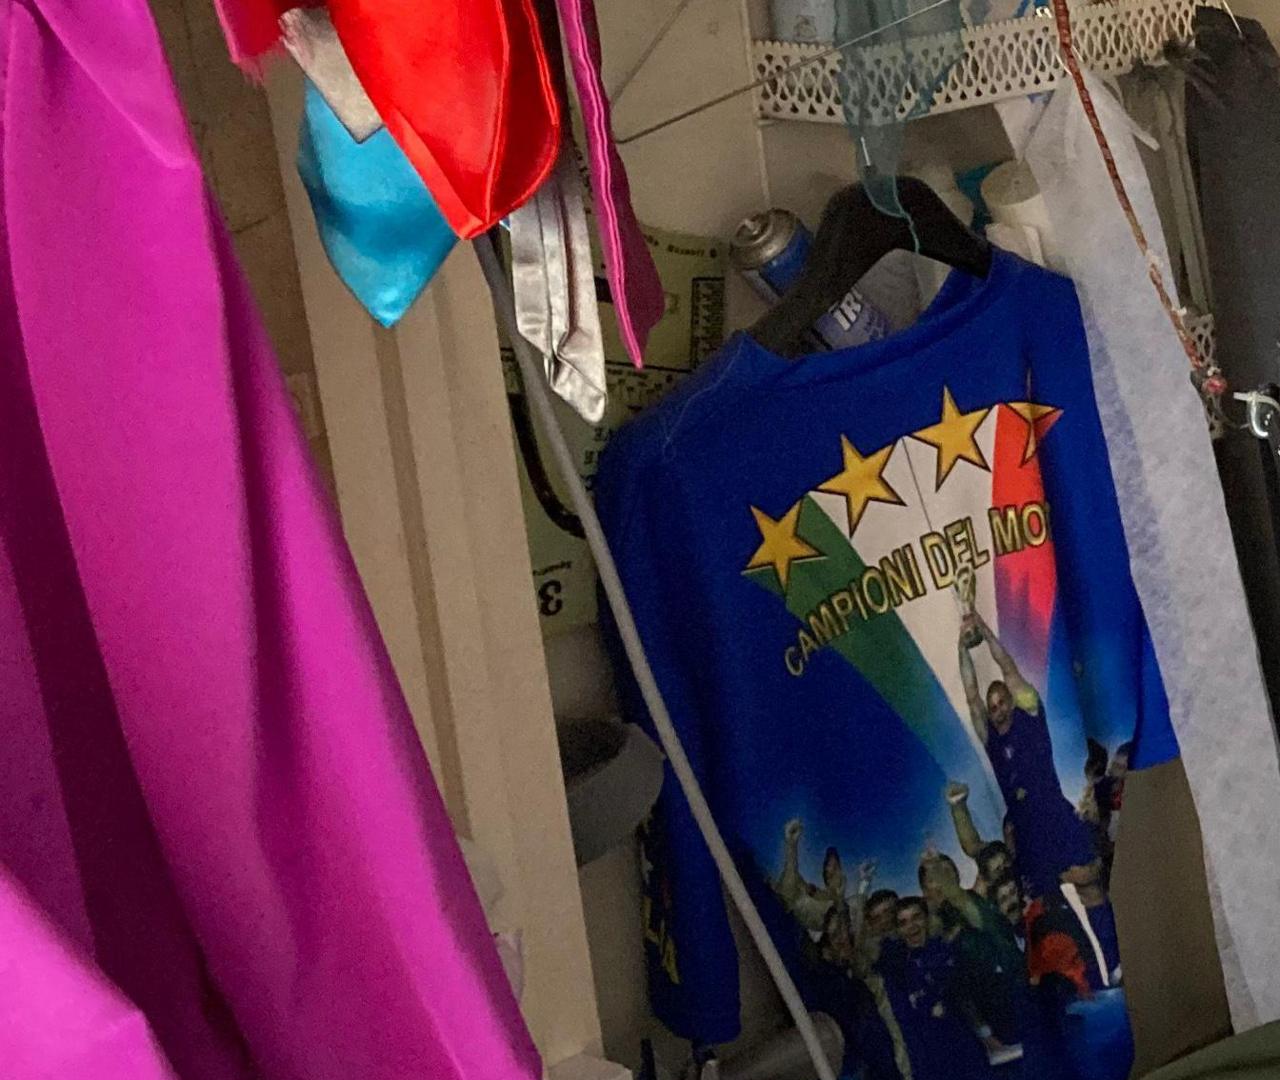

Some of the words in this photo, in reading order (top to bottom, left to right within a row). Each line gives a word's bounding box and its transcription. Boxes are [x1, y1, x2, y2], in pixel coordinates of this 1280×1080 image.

[783, 545, 927, 678] CAMPIONI
[920, 517, 990, 590] DEL
[990, 501, 1053, 558] MO
